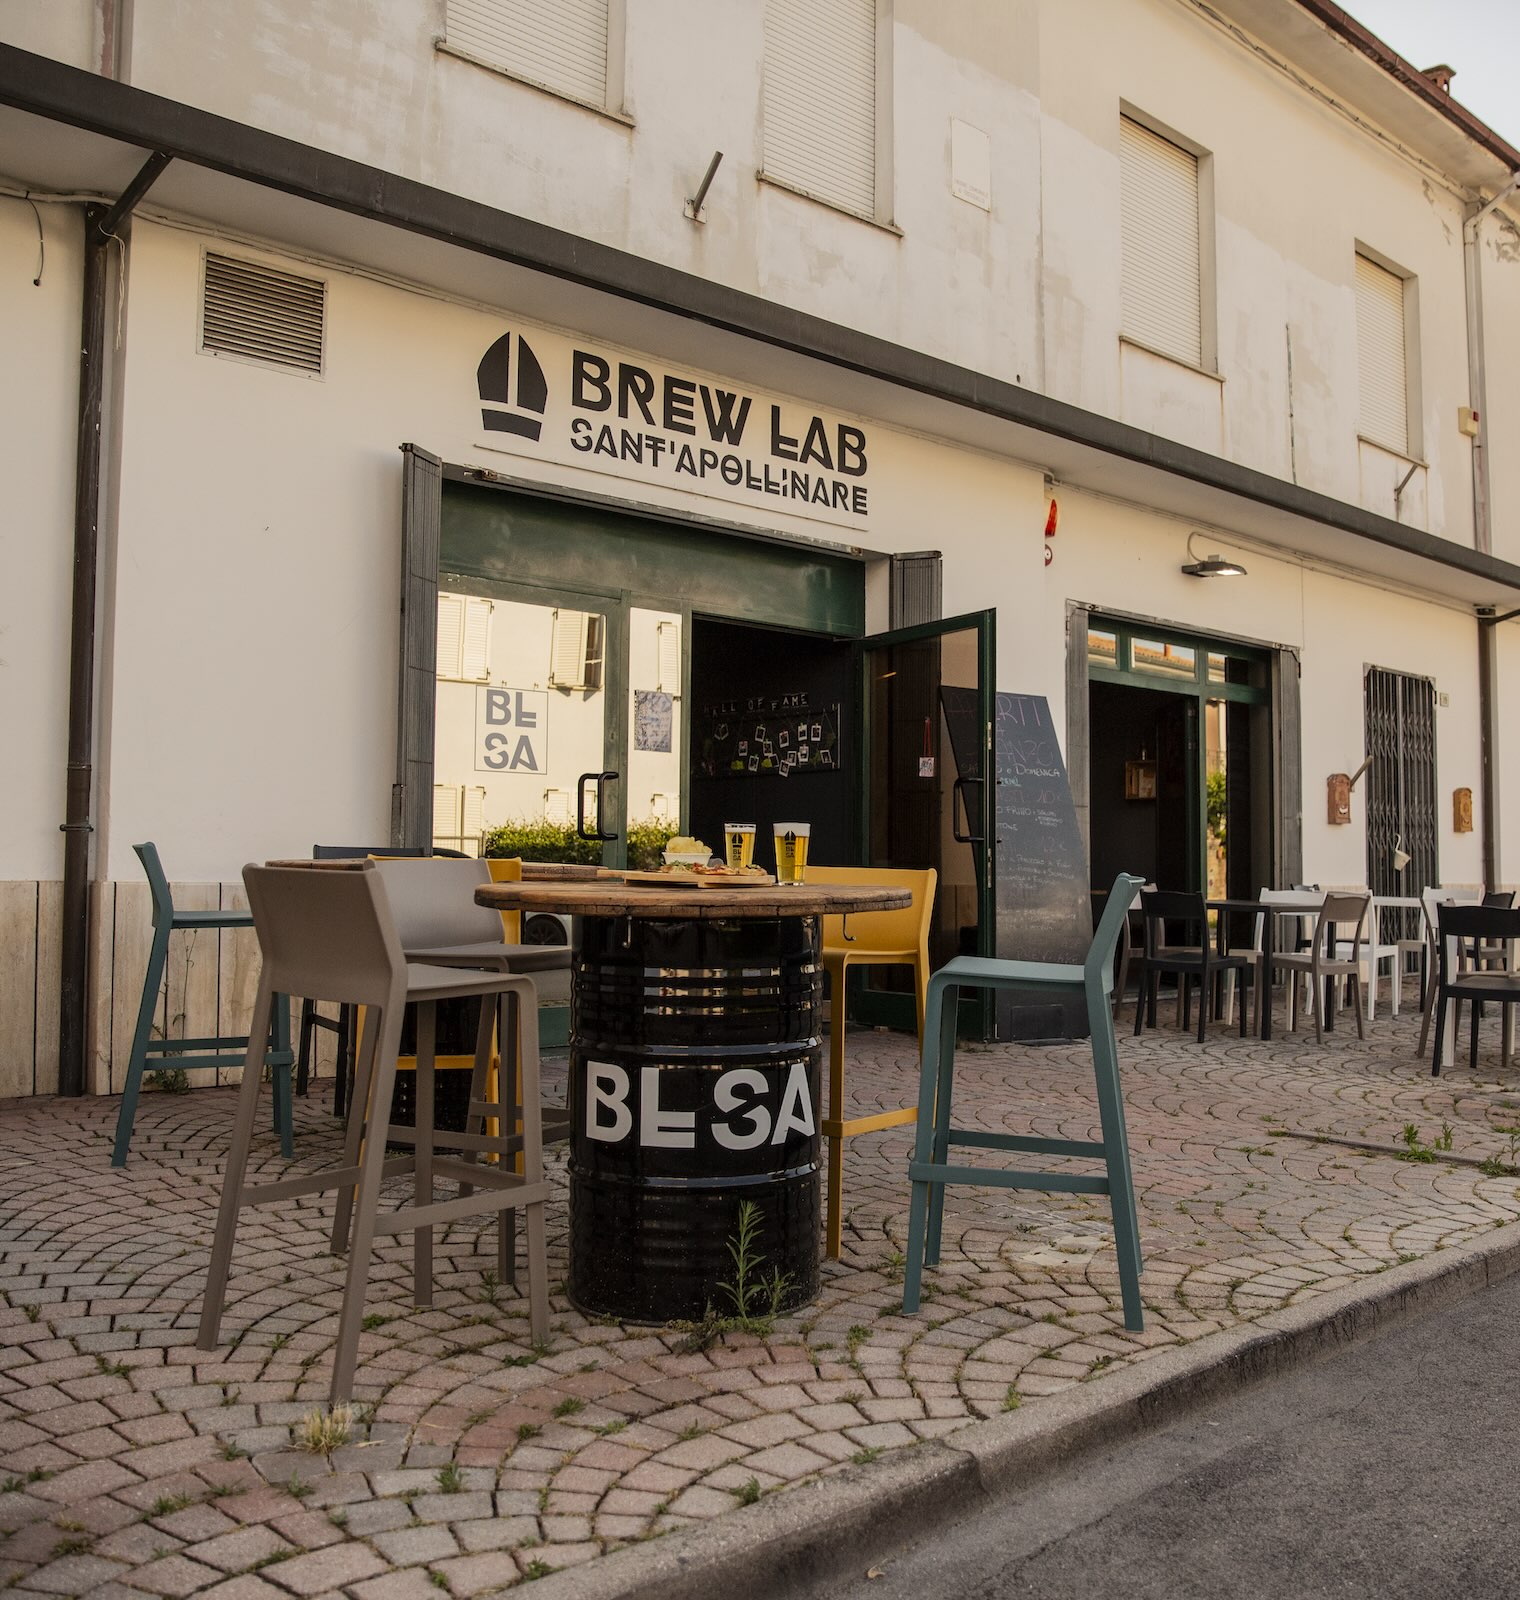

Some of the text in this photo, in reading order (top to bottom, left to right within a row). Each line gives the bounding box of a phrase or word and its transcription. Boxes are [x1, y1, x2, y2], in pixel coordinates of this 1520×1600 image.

[571, 349, 868, 477] BREW LAB
[570, 418, 869, 516] SANT'APOLLINARE
[485, 689, 537, 728] BL
[747, 699, 764, 711] OF
[771, 694, 809, 711] FAME
[483, 732, 539, 771] SA
[585, 1060, 816, 1151] BLSA
